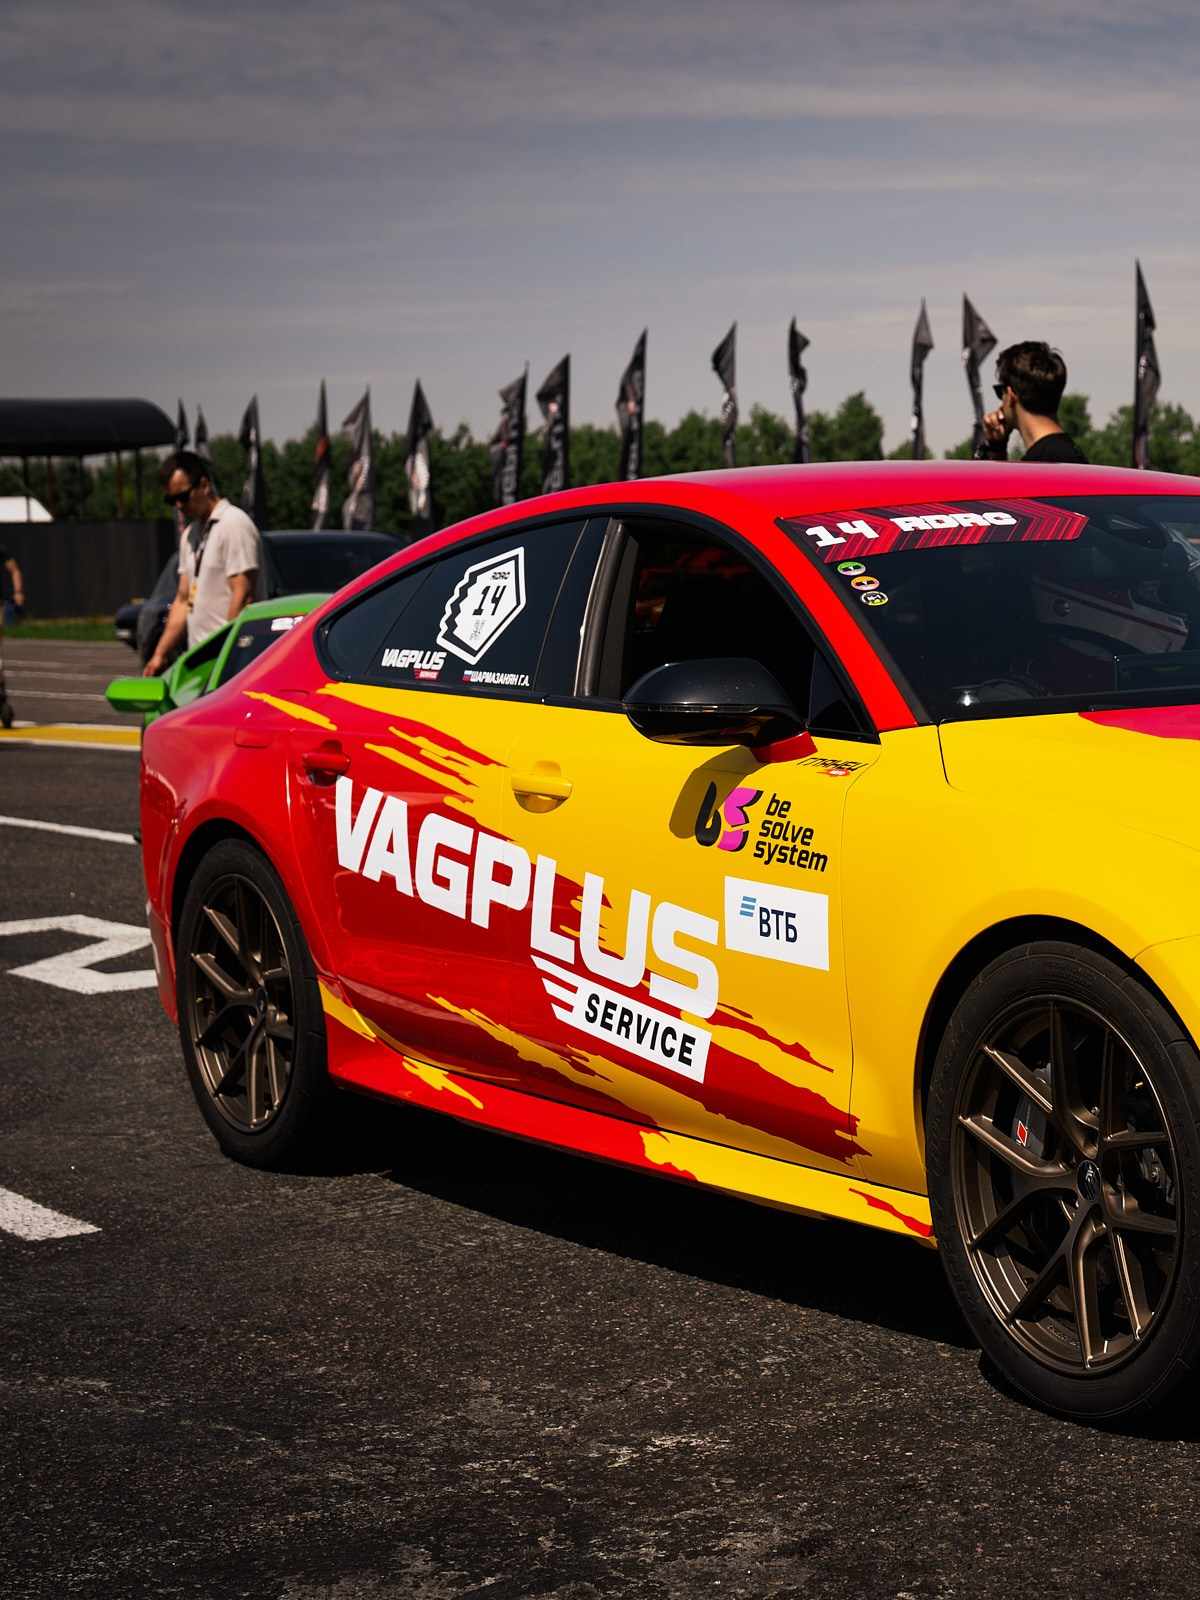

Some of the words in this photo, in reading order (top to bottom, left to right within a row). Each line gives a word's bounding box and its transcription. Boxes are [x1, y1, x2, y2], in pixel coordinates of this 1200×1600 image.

[805, 519, 880, 548] 14
[890, 511, 1017, 532] RDRC
[472, 585, 507, 616] 14
[381, 649, 447, 670] VAGPLUS
[766, 793, 792, 819] be
[759, 818, 815, 847] solve
[753, 840, 829, 873] system
[335, 775, 720, 1019] VAGPLUS
[758, 906, 798, 944] ВТБ
[583, 993, 697, 1067] SERVICE
